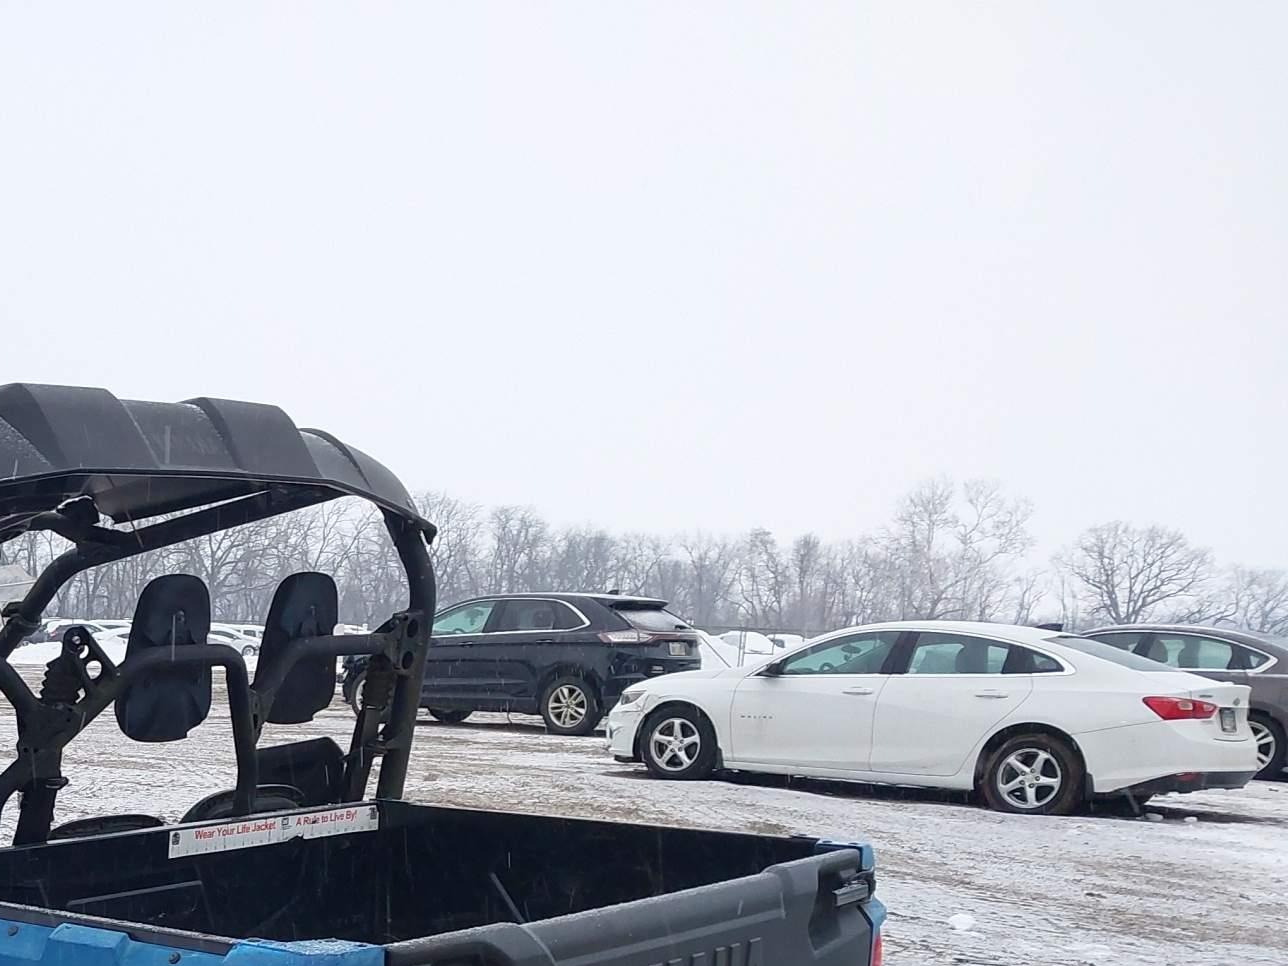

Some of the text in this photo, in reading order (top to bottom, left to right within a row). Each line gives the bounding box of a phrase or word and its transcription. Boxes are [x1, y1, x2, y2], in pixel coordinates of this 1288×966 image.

[194, 829, 216, 840] Wear
[216, 825, 235, 837] Your
[236, 822, 251, 835] Life
[252, 819, 277, 832] Jacket
[296, 816, 303, 826] A
[321, 812, 329, 823] to
[329, 811, 345, 822] Live
[345, 809, 358, 821] By!
